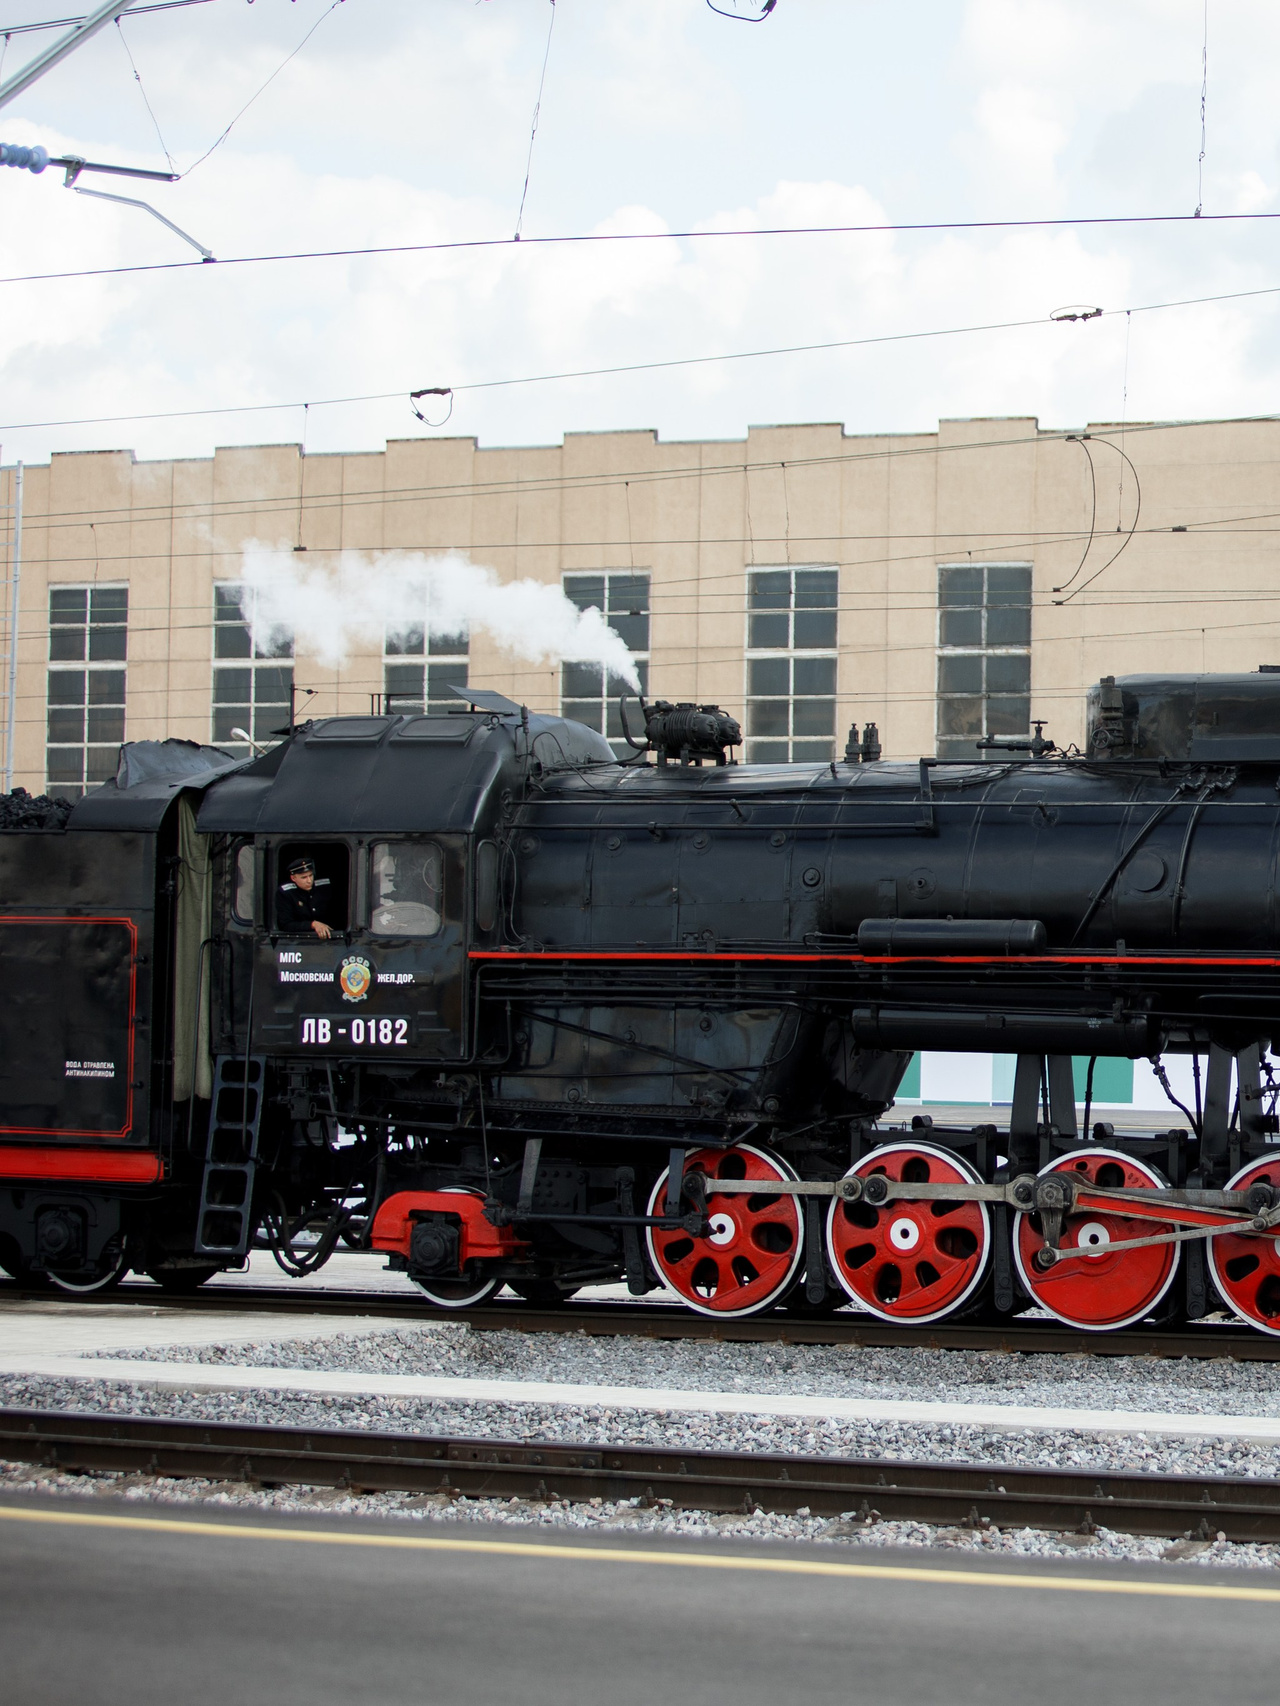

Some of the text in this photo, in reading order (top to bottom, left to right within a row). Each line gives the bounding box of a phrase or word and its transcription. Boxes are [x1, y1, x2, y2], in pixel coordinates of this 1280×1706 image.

[279, 952, 302, 963] МПС
[65, 1060, 115, 1069] ВОДА ОТРАВЛЕНА
[65, 1069, 115, 1078] АНТИНАКИПИНОМ
